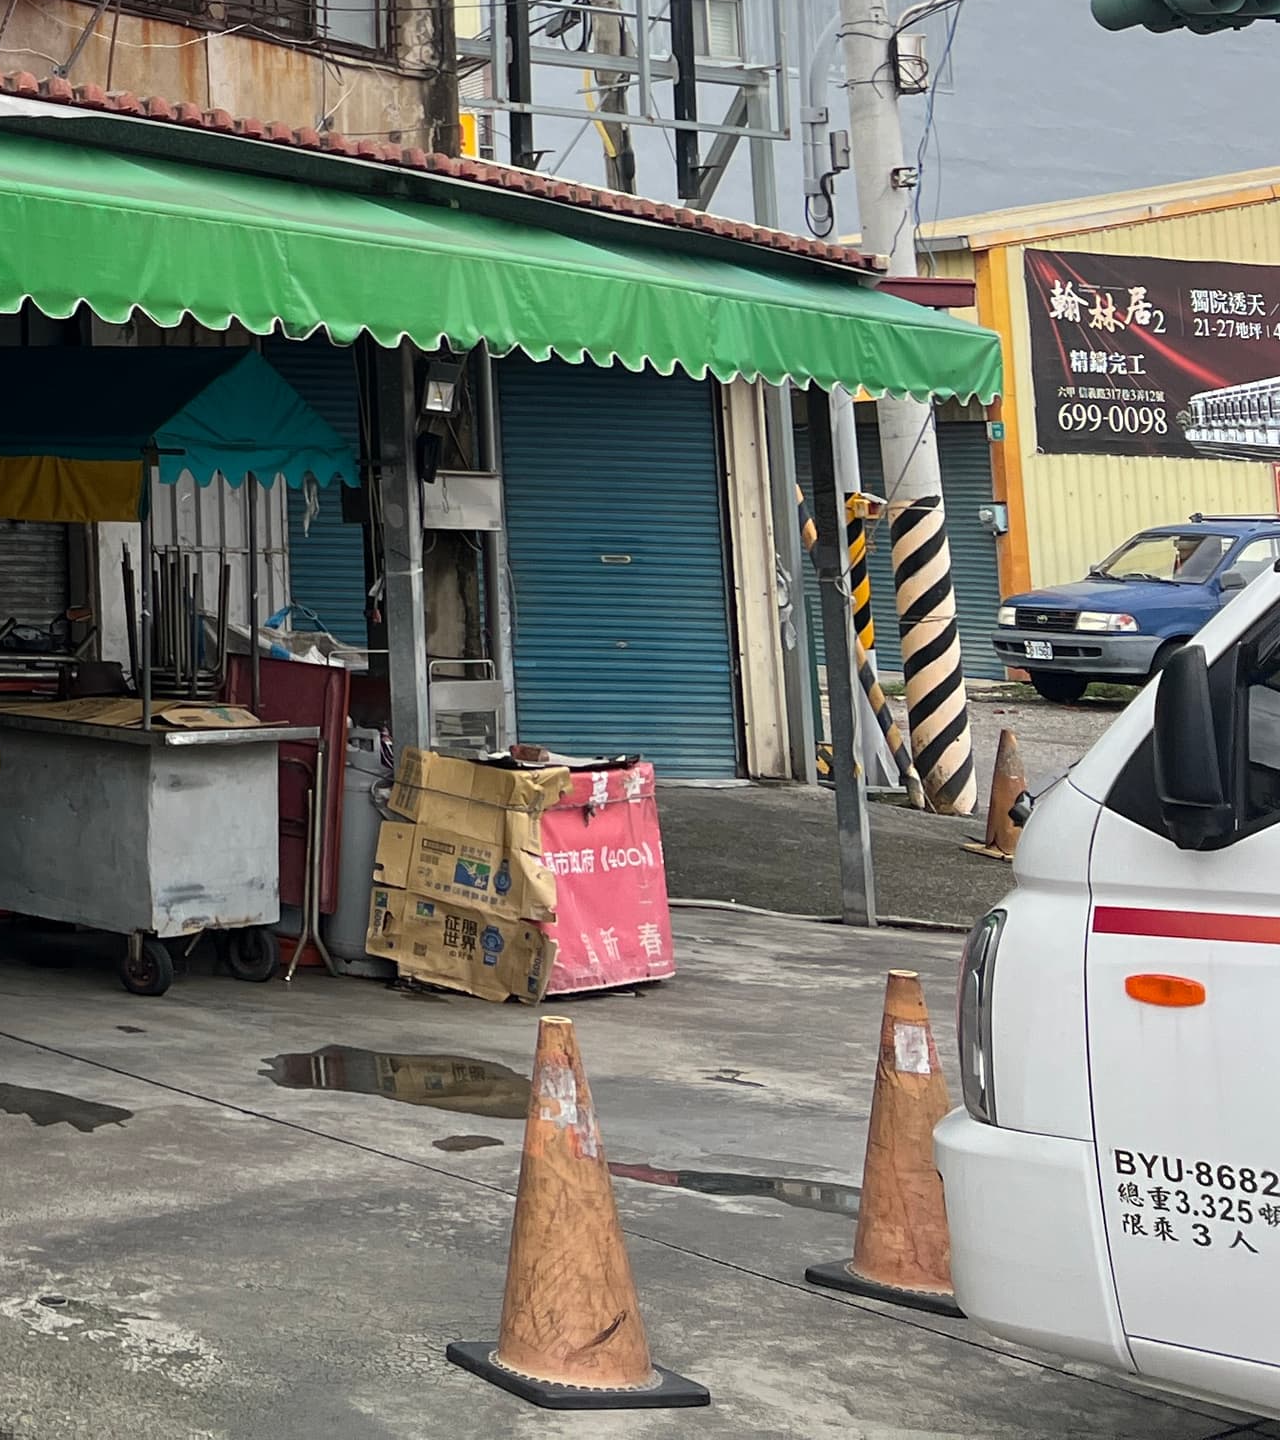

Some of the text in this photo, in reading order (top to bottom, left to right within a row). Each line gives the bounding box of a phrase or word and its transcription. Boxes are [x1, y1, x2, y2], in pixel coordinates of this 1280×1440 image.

[1058, 403, 1168, 434] 699-0098
[443, 930, 476, 952] 世界
[1114, 1148, 1280, 1198] BYU-8682
